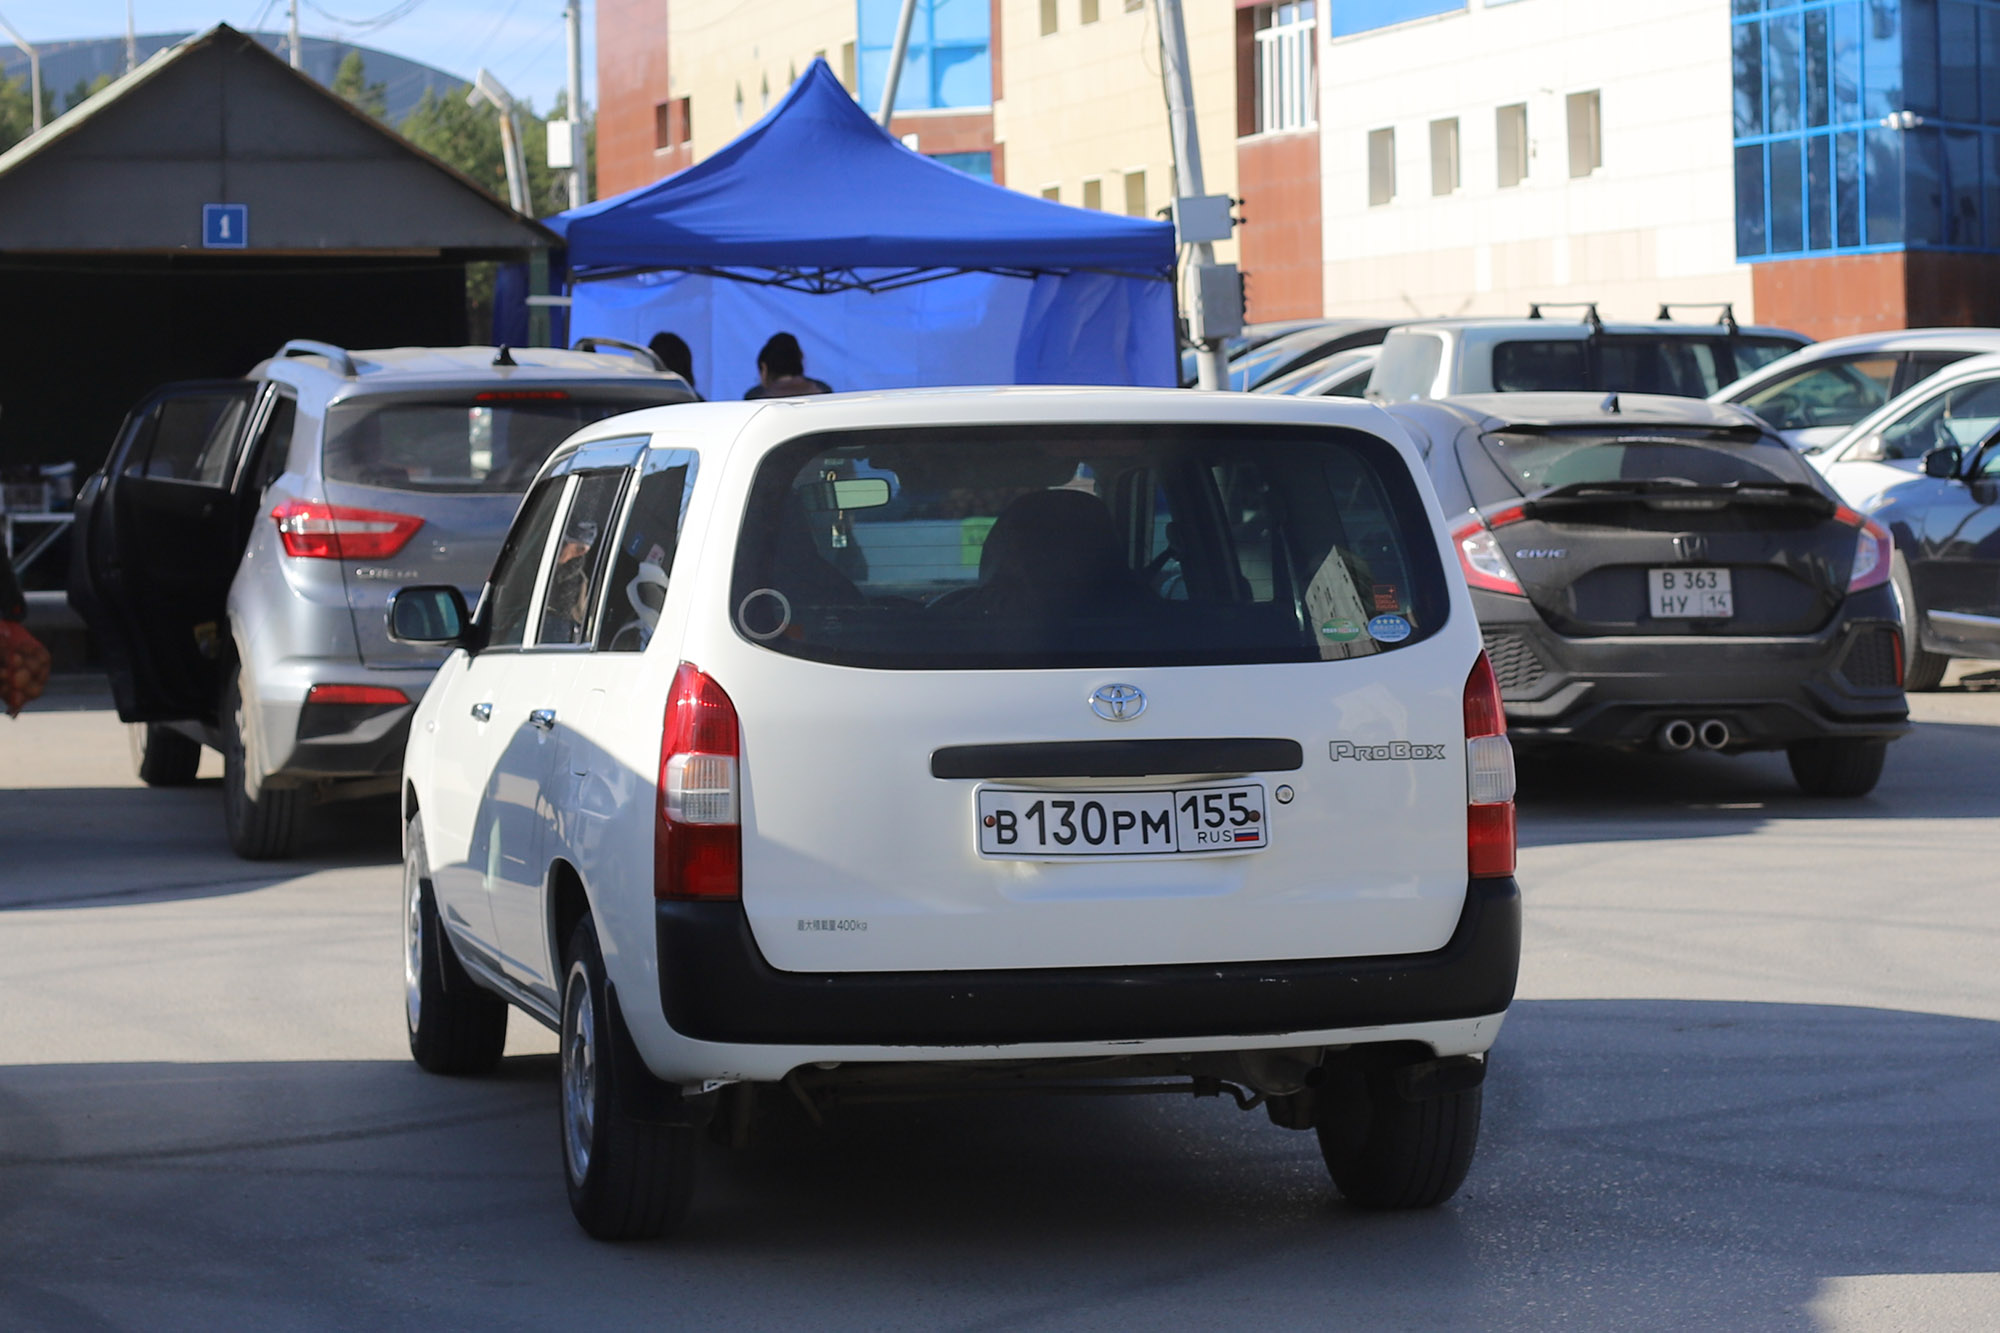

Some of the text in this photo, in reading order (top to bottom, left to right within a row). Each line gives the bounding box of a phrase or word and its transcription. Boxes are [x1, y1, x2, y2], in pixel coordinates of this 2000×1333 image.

[219, 214, 231, 239] 1
[1515, 548, 1567, 559] CIVIC
[1708, 595, 1727, 609] 14
[1180, 792, 1250, 830] 155
[1197, 830, 1233, 843] RUS
